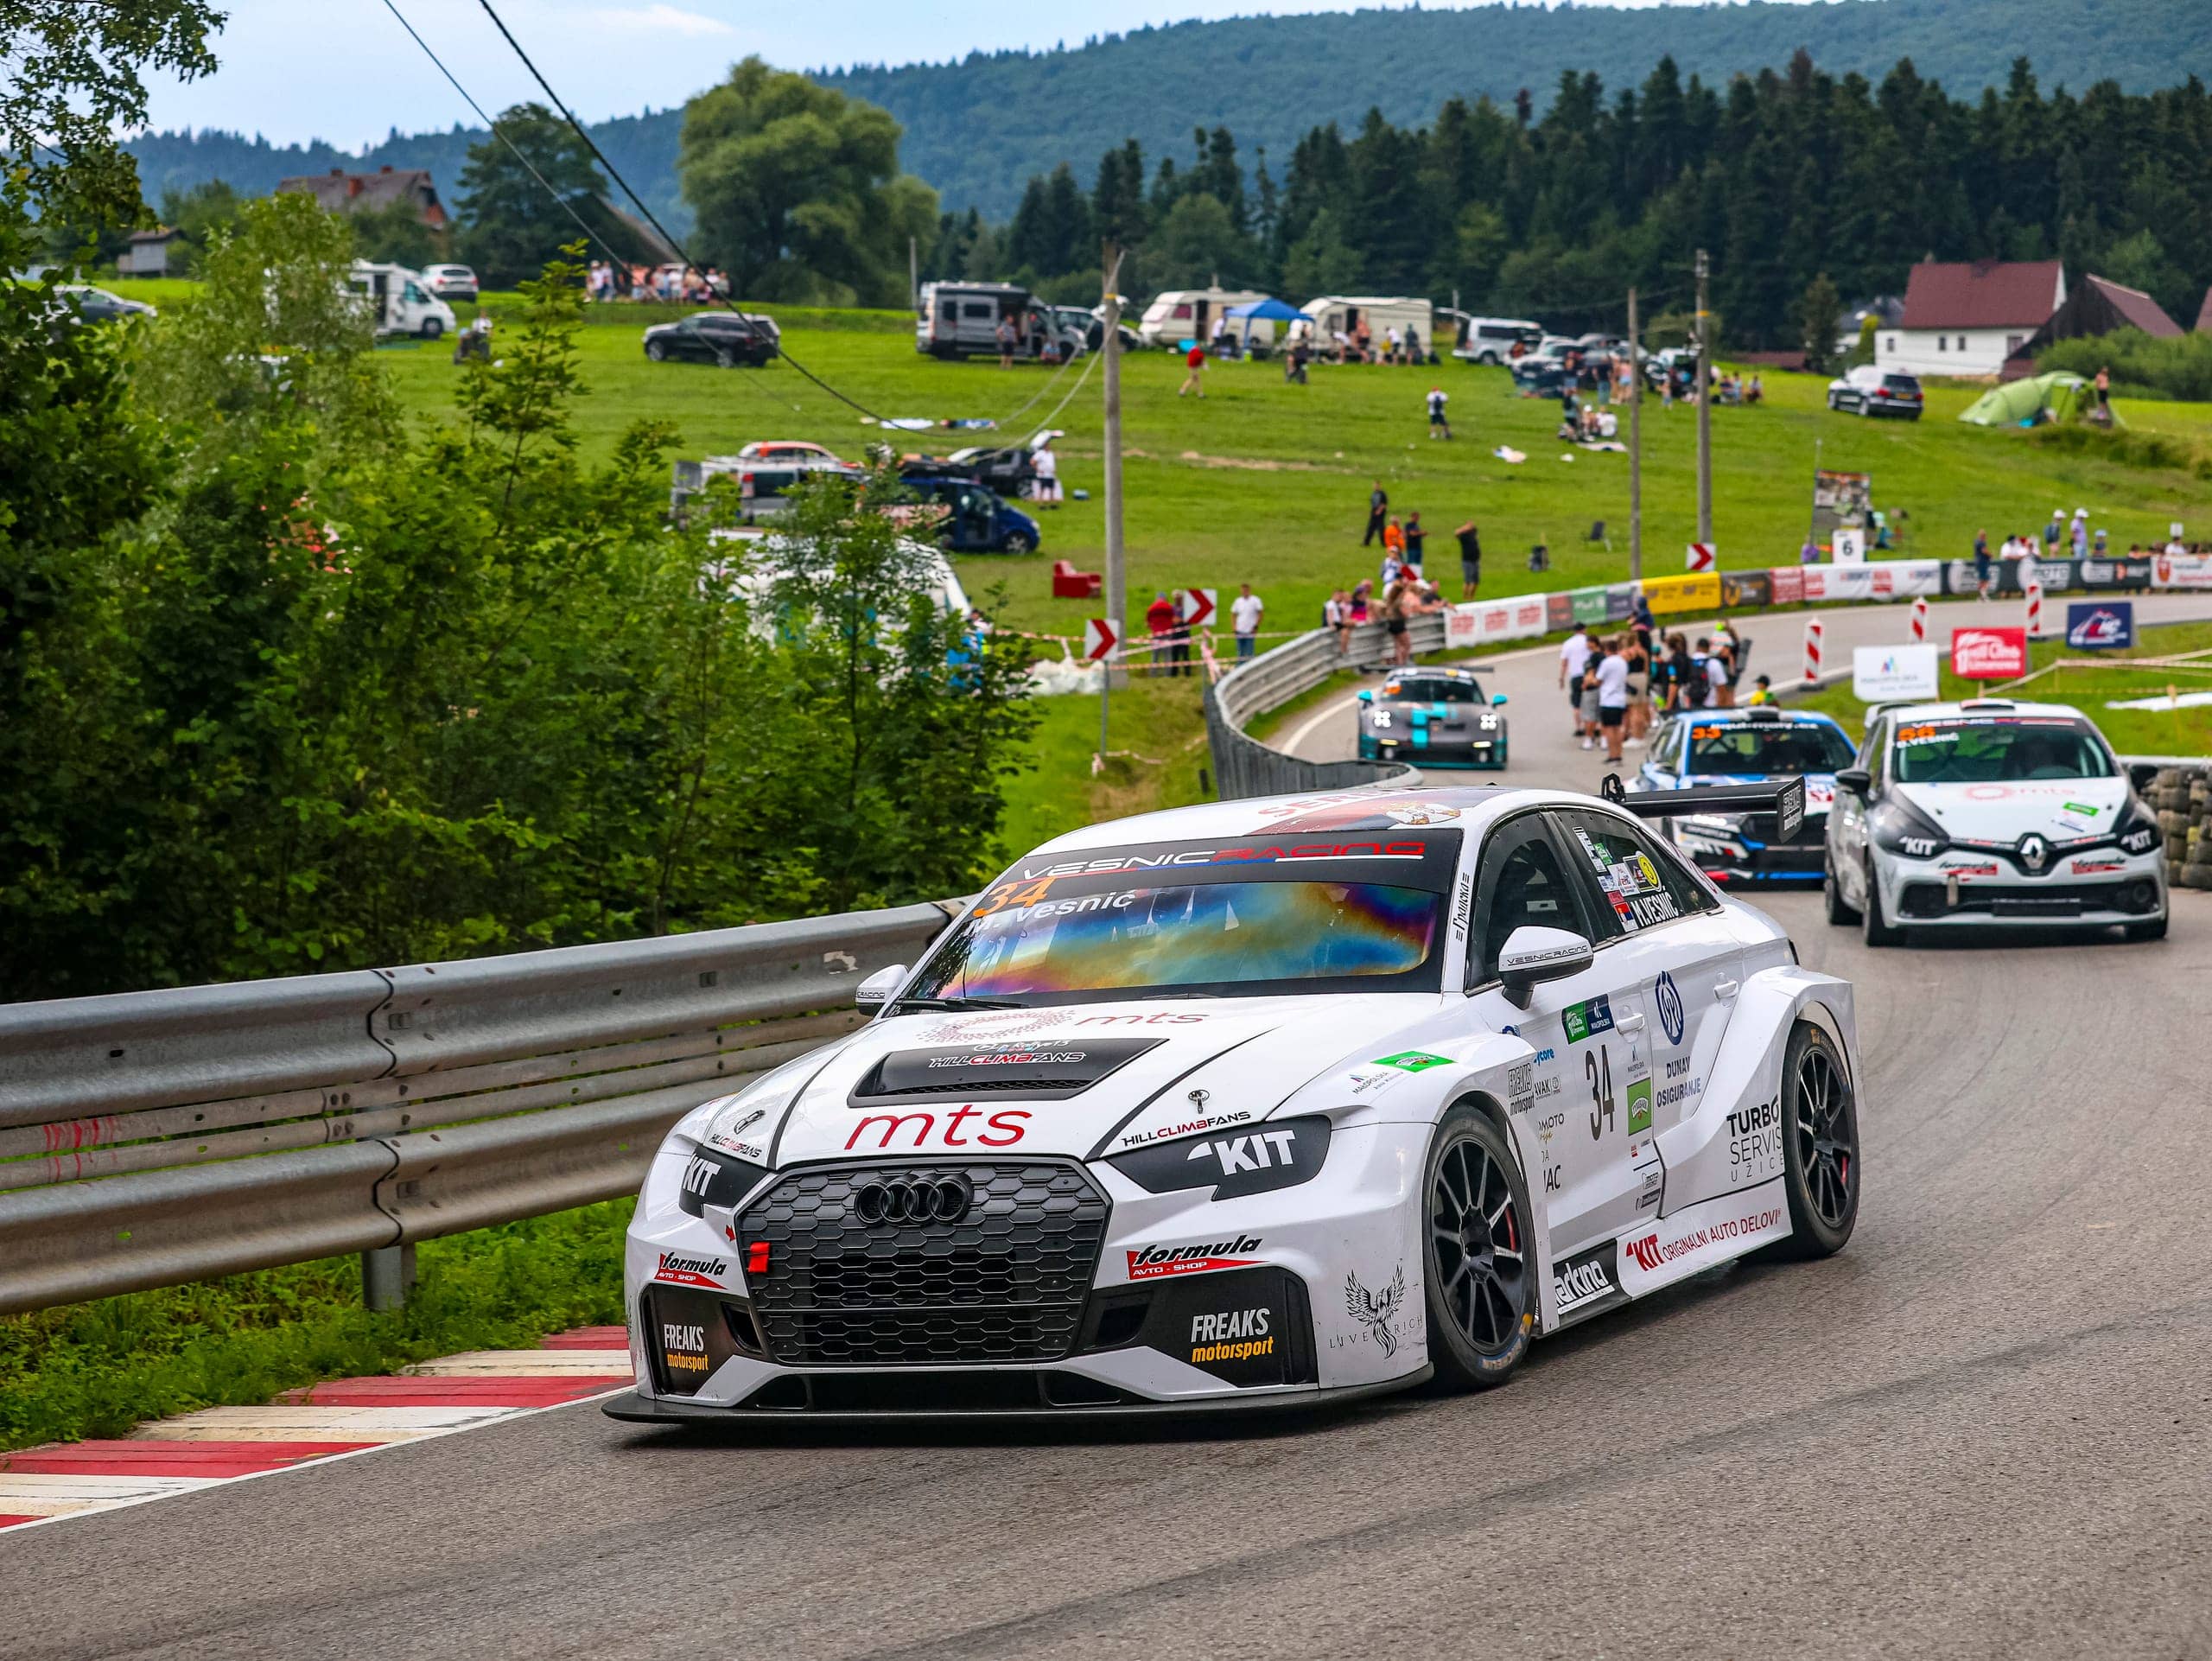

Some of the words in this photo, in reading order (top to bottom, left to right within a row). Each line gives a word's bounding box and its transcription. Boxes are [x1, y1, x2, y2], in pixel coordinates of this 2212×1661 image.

[1842, 540, 1853, 556] 6
[1905, 837, 1936, 856] KIT
[973, 875, 1057, 918] 34
[1015, 888, 1136, 923] Vesnić
[1075, 1012, 1211, 1027] mts
[929, 1051, 1087, 1068] HILLCLIMBFANS
[1666, 1056, 1691, 1079] DUNAV
[1586, 1044, 1614, 1141] 34
[1656, 1078, 1701, 1108] OSIGURANJE
[844, 1104, 1033, 1150] mts
[1122, 1111, 1251, 1147] HILLCLIMBFANS
[1726, 1092, 1780, 1137] TURBO
[1214, 1130, 1296, 1176] KIT
[1730, 1126, 1782, 1165] SERVIS
[682, 1153, 722, 1197] KIT
[1133, 1234, 1263, 1266] formula
[1632, 1233, 1665, 1272] KIT
[1662, 1229, 1710, 1262] ORIGINALNI
[1710, 1220, 1738, 1243] AUTO
[662, 1251, 728, 1276] formula
[1133, 1266, 1164, 1276] AVTO
[1173, 1261, 1207, 1272] SHOP
[664, 1323, 704, 1352] FREAKS
[1191, 1307, 1270, 1343] FREAKS
[667, 1352, 709, 1372] motorsport
[1192, 1335, 1274, 1364] motorsport
